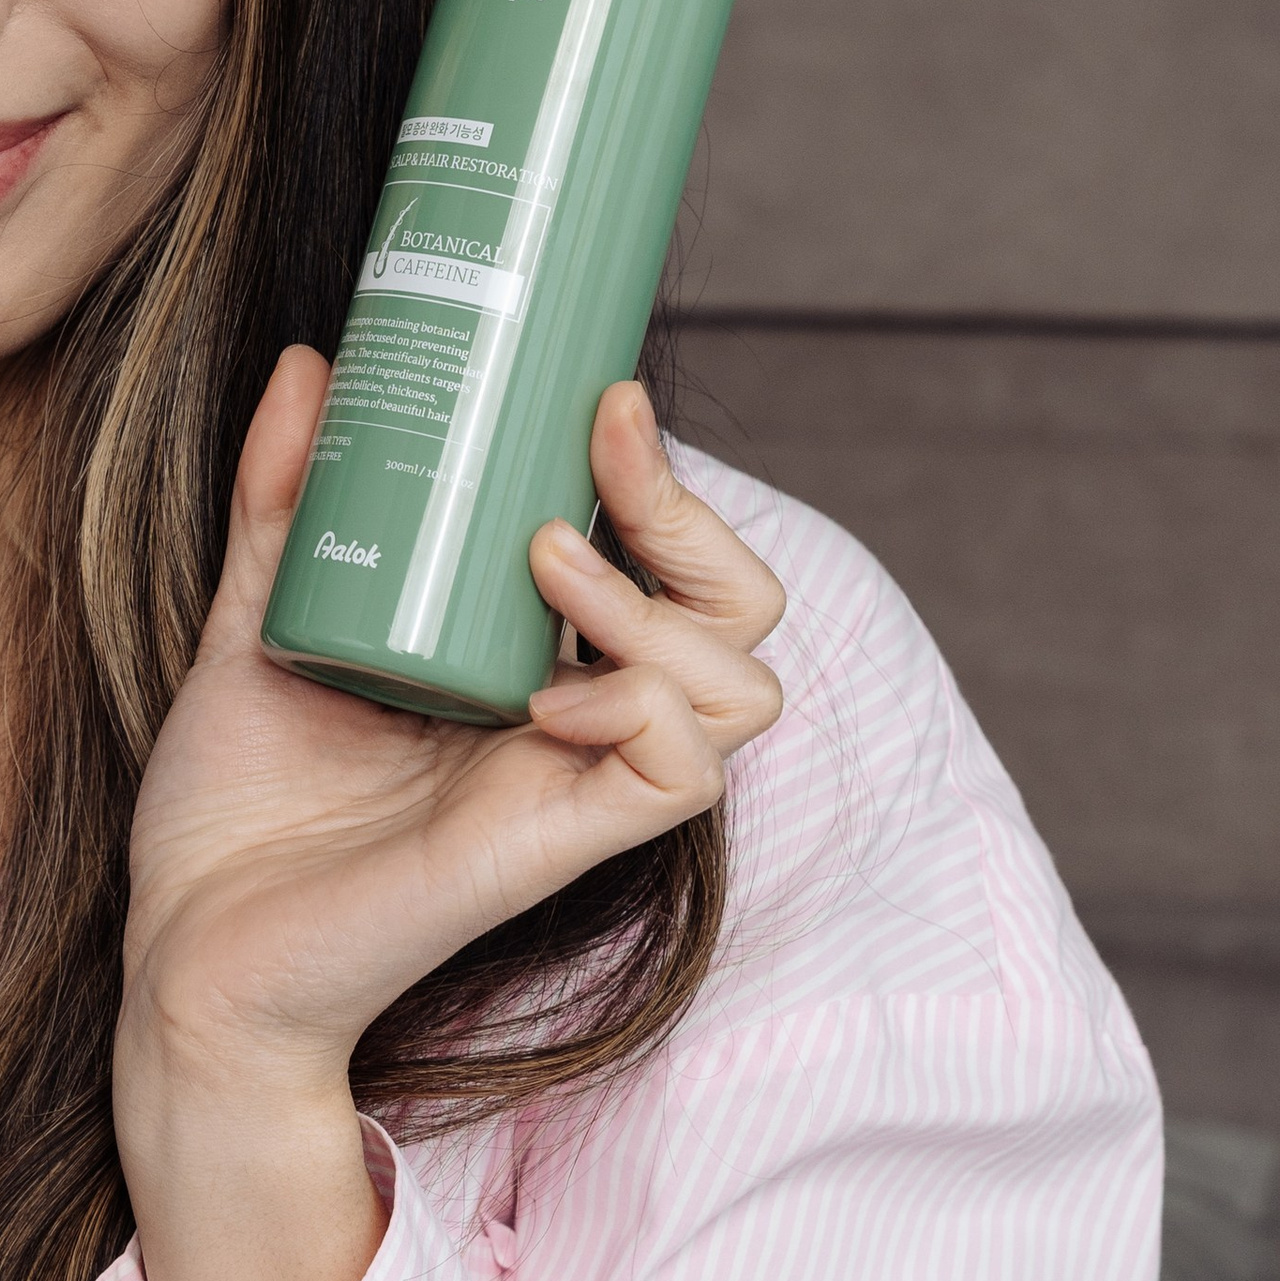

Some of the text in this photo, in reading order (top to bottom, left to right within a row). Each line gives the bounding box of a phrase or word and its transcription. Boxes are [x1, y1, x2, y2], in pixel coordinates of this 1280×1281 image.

[413, 122, 429, 136] 증상
[429, 121, 449, 136] 완화
[449, 123, 485, 141] 기능성
[411, 153, 418, 166] &
[418, 152, 449, 168] HAIR
[452, 155, 559, 192] RESTORATION
[400, 230, 505, 265] BOTANICAL
[393, 257, 481, 287] CAFFEINE
[373, 317, 420, 333] containing
[421, 322, 470, 342] botanical
[358, 347, 372, 358] The
[372, 349, 431, 369] scientifically
[366, 331, 397, 344] focused
[397, 337, 409, 346] on
[410, 337, 470, 361] preventing
[352, 379, 385, 396] follicles,
[387, 384, 438, 405] thickness,
[367, 364, 376, 375] of
[376, 364, 431, 384] ingredients
[433, 376, 471, 394] targets
[340, 396, 369, 408] creation
[370, 398, 381, 410] of
[381, 400, 427, 418] beautiful
[427, 408, 453, 424] hair.
[332, 436, 352, 446] TYPES
[384, 459, 419, 474] 300ml
[418, 466, 426, 477] /
